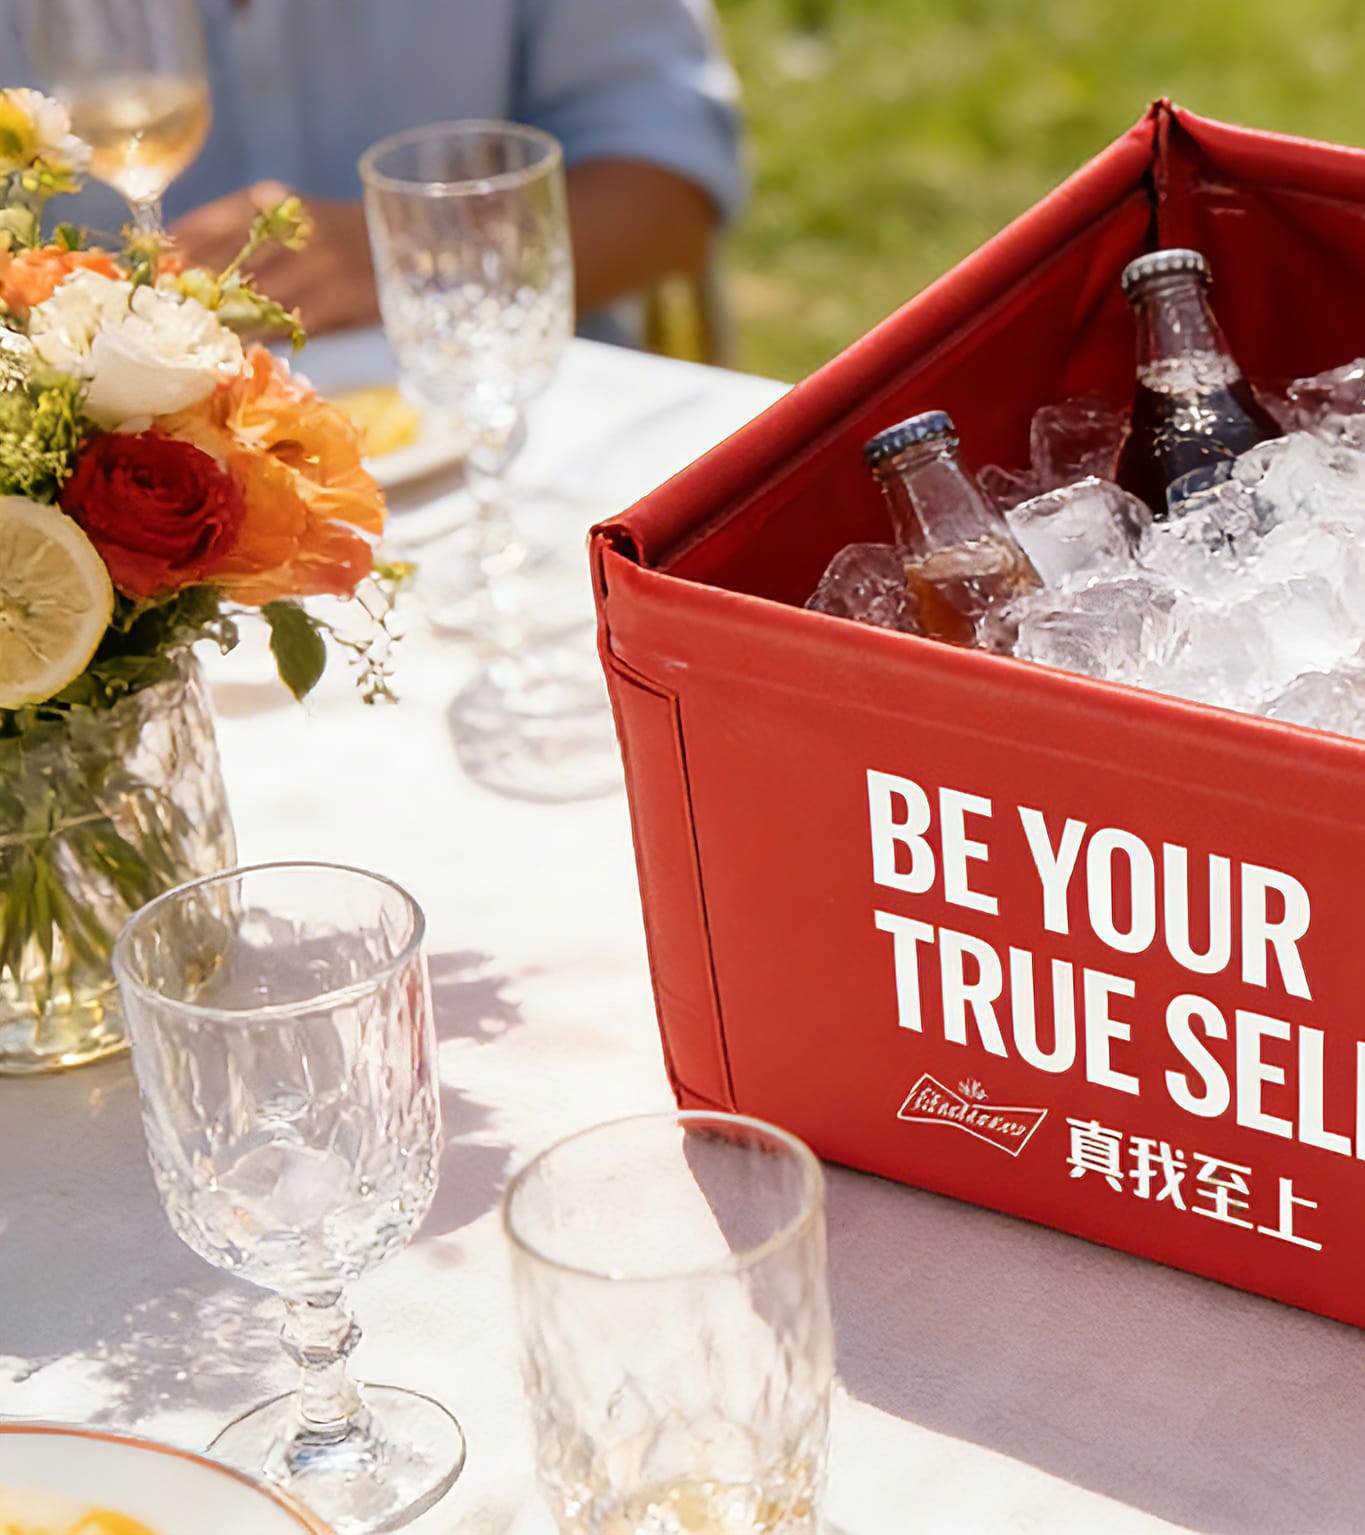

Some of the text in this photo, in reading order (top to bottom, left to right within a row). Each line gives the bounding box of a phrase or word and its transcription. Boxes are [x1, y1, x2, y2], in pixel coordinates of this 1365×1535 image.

[866, 768, 1313, 1001] BE YOUR
[873, 909, 1140, 1097] TRUE
[1064, 1116, 1324, 1253] 真我至上
